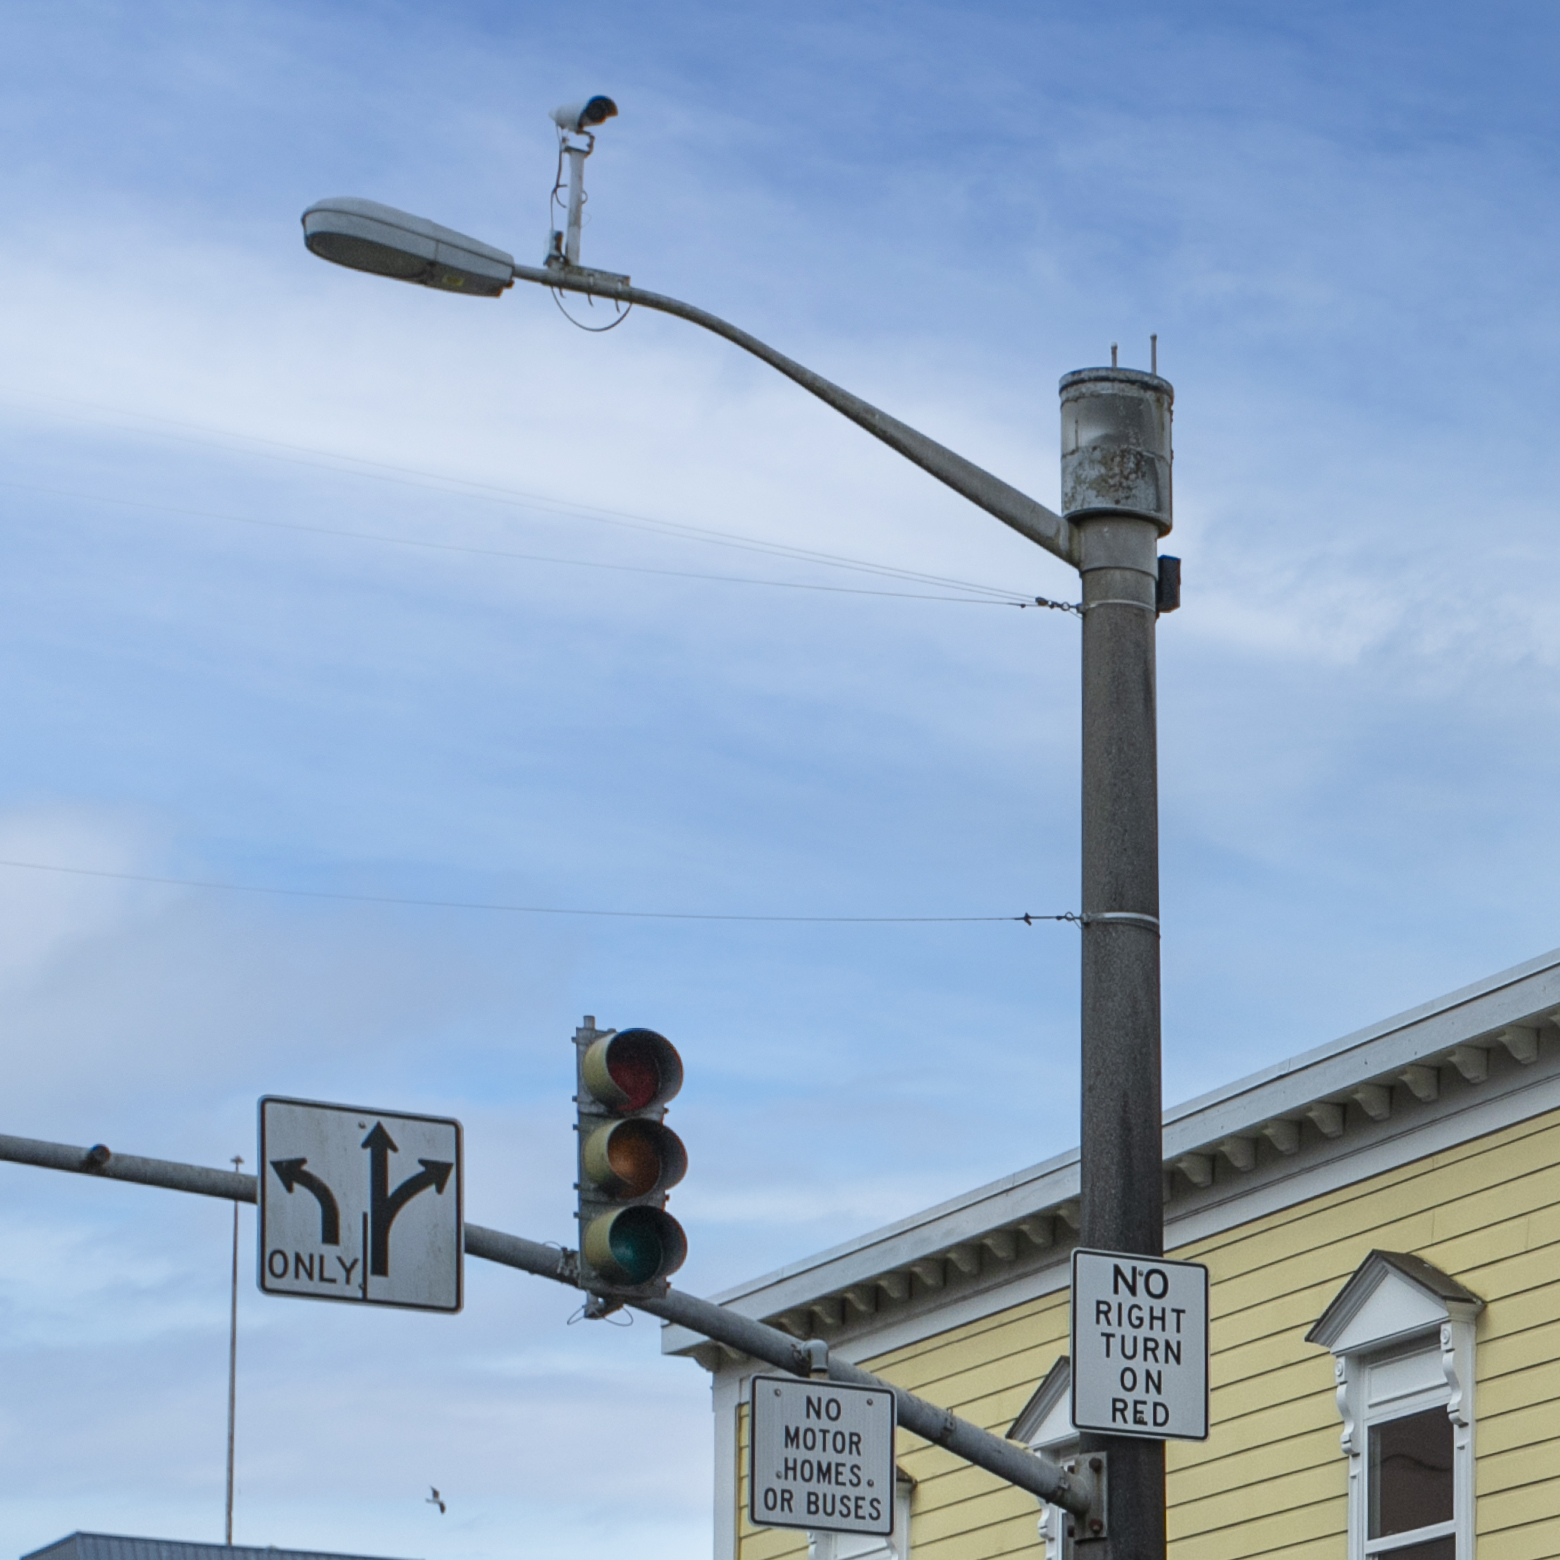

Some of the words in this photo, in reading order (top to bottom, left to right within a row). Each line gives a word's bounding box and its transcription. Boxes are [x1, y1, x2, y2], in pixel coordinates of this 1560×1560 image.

[268, 1249, 359, 1285] ONLY
[1112, 1264, 1169, 1299] NO
[1096, 1301, 1186, 1334] RIGHT
[1101, 1332, 1182, 1365] TURN
[1120, 1367, 1162, 1395] ON
[806, 1396, 841, 1422] NO
[1112, 1398, 1169, 1428] RED
[784, 1425, 862, 1456] MOTOR
[783, 1459, 862, 1488] HOMES
[764, 1488, 794, 1514] OR
[806, 1491, 881, 1521] BUSES
